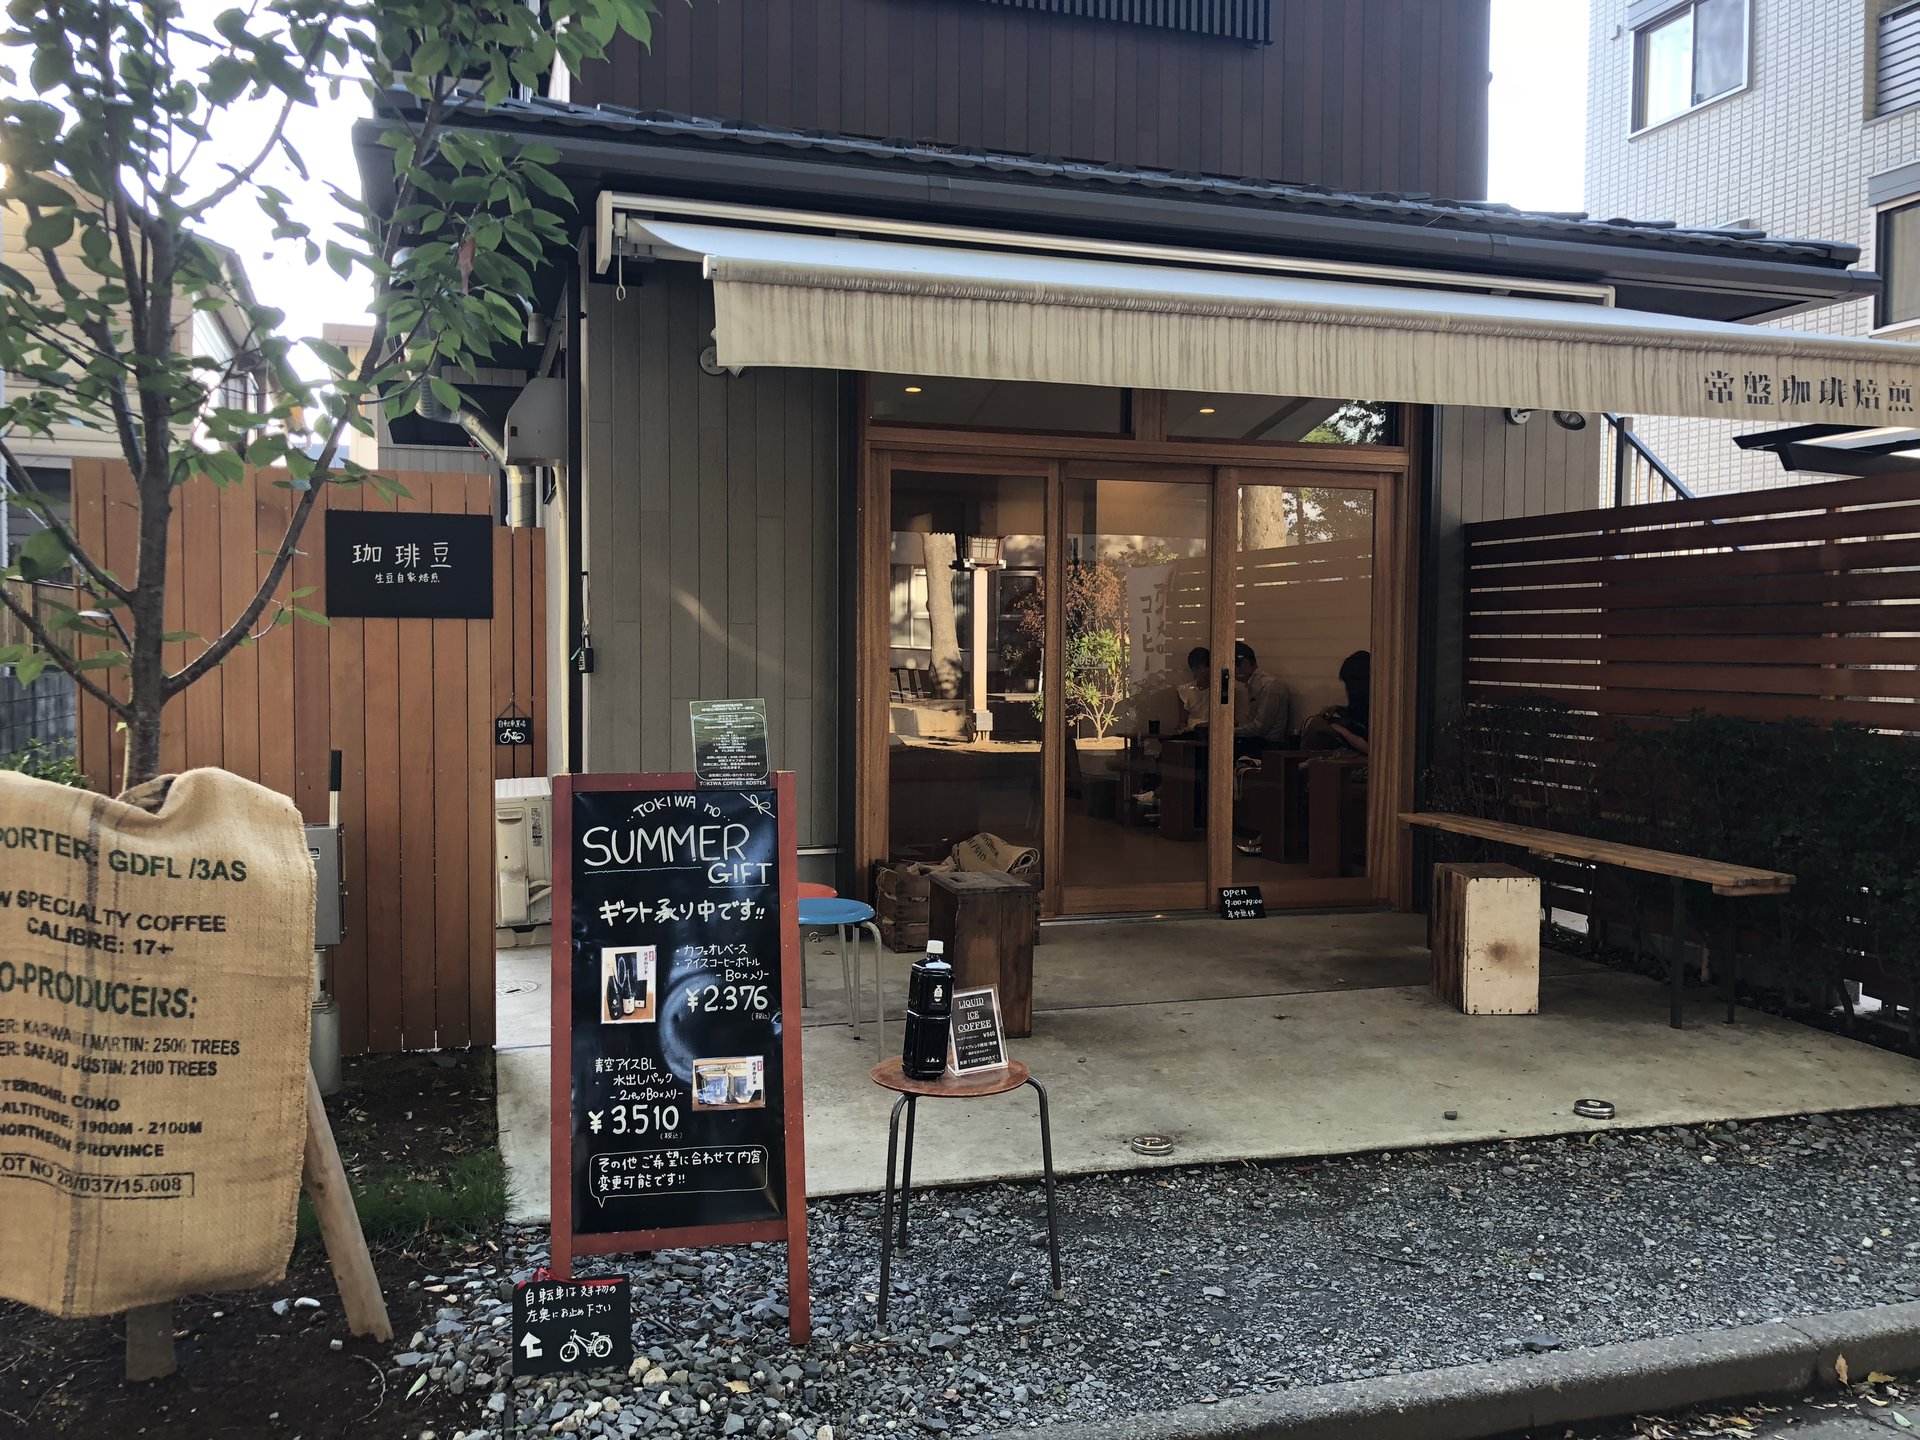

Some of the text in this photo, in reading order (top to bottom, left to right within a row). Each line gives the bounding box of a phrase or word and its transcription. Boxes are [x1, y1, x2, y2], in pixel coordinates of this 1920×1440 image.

[1704, 370, 1914, 412] 常盤珈琲焙煎
[352, 541, 452, 568] 珈琲豆
[374, 572, 440, 584] 生豆自家焙煎
[0, 827, 99, 867] ORTER:
[108, 850, 183, 880] GDFL
[582, 823, 751, 867] SUMMER
[707, 862, 773, 885] GIFT
[17, 889, 132, 929] SPECIALTY
[136, 914, 227, 933] COFFEE
[27, 917, 175, 956] CALIBRE: 17+
[958, 997, 985, 1010] LIQUID
[957, 1020, 992, 1033] COFFEE
[966, 1011, 980, 1021] ICE
[152, 1037, 187, 1053] 2500
[191, 1039, 241, 1056] TREES
[23, 1041, 69, 1068] SAFARI
[71, 1055, 127, 1075] JUSTIN:
[130, 1059, 164, 1076] 2100
[168, 1060, 218, 1077] TREES
[612, 1072, 674, 1086] 水出しパック
[79, 1120, 133, 1135] 1900M
[148, 1120, 203, 1134] 2100M
[75, 1142, 165, 1158] PROVINCE
[0, 1156, 25, 1172] OT
[30, 1159, 54, 1178] NO
[525, 1303, 612, 1323] 左奥にお止め下さい
